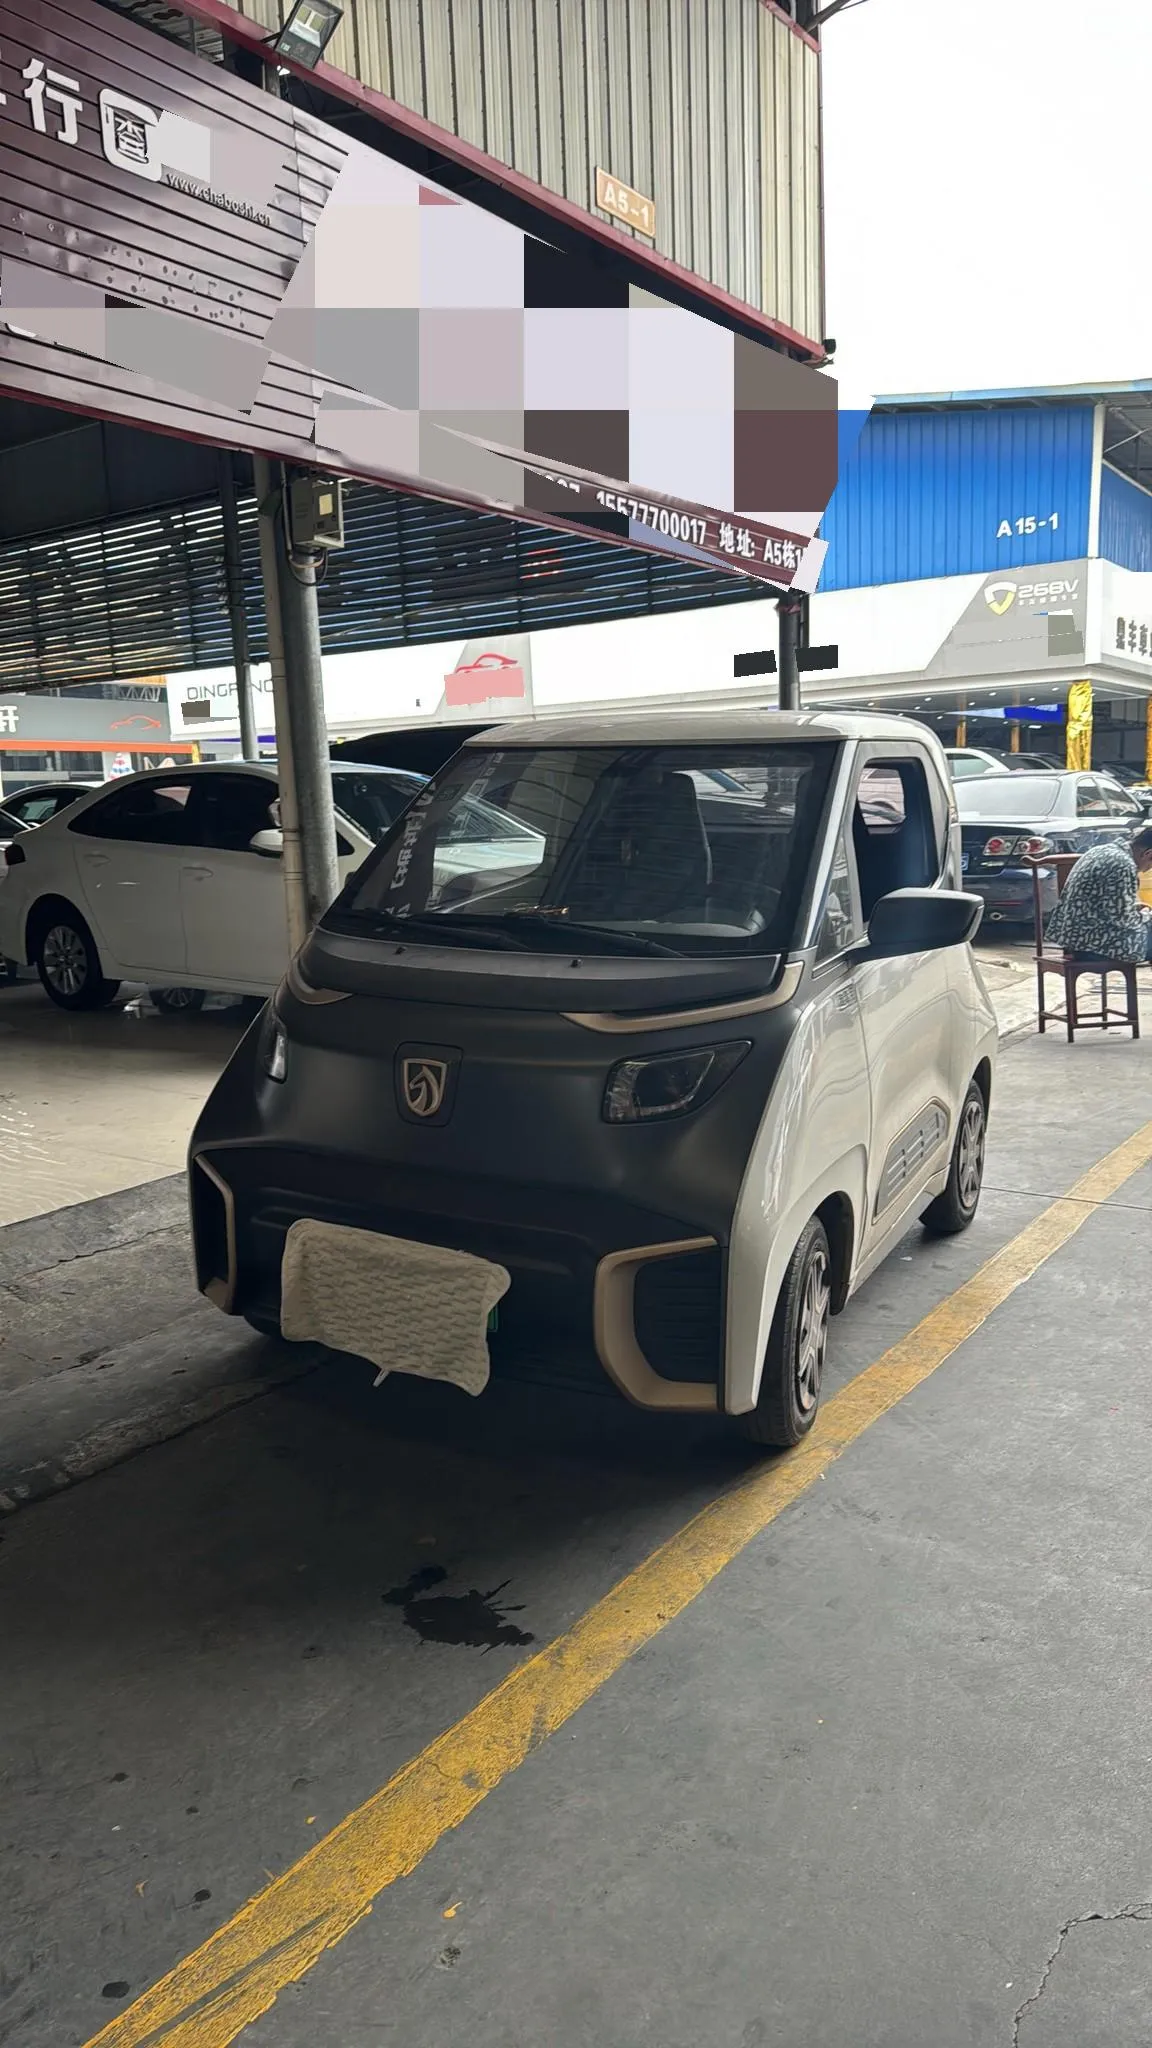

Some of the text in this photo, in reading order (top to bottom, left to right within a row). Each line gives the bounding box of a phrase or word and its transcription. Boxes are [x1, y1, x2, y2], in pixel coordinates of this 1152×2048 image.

[0, 56, 83, 145] 行
[166, 173, 271, 226] www.chaboshi.cn
[604, 181, 649, 227] A5-1
[763, 539, 808, 569] A5栋1
[1018, 579, 1079, 598] 268V
